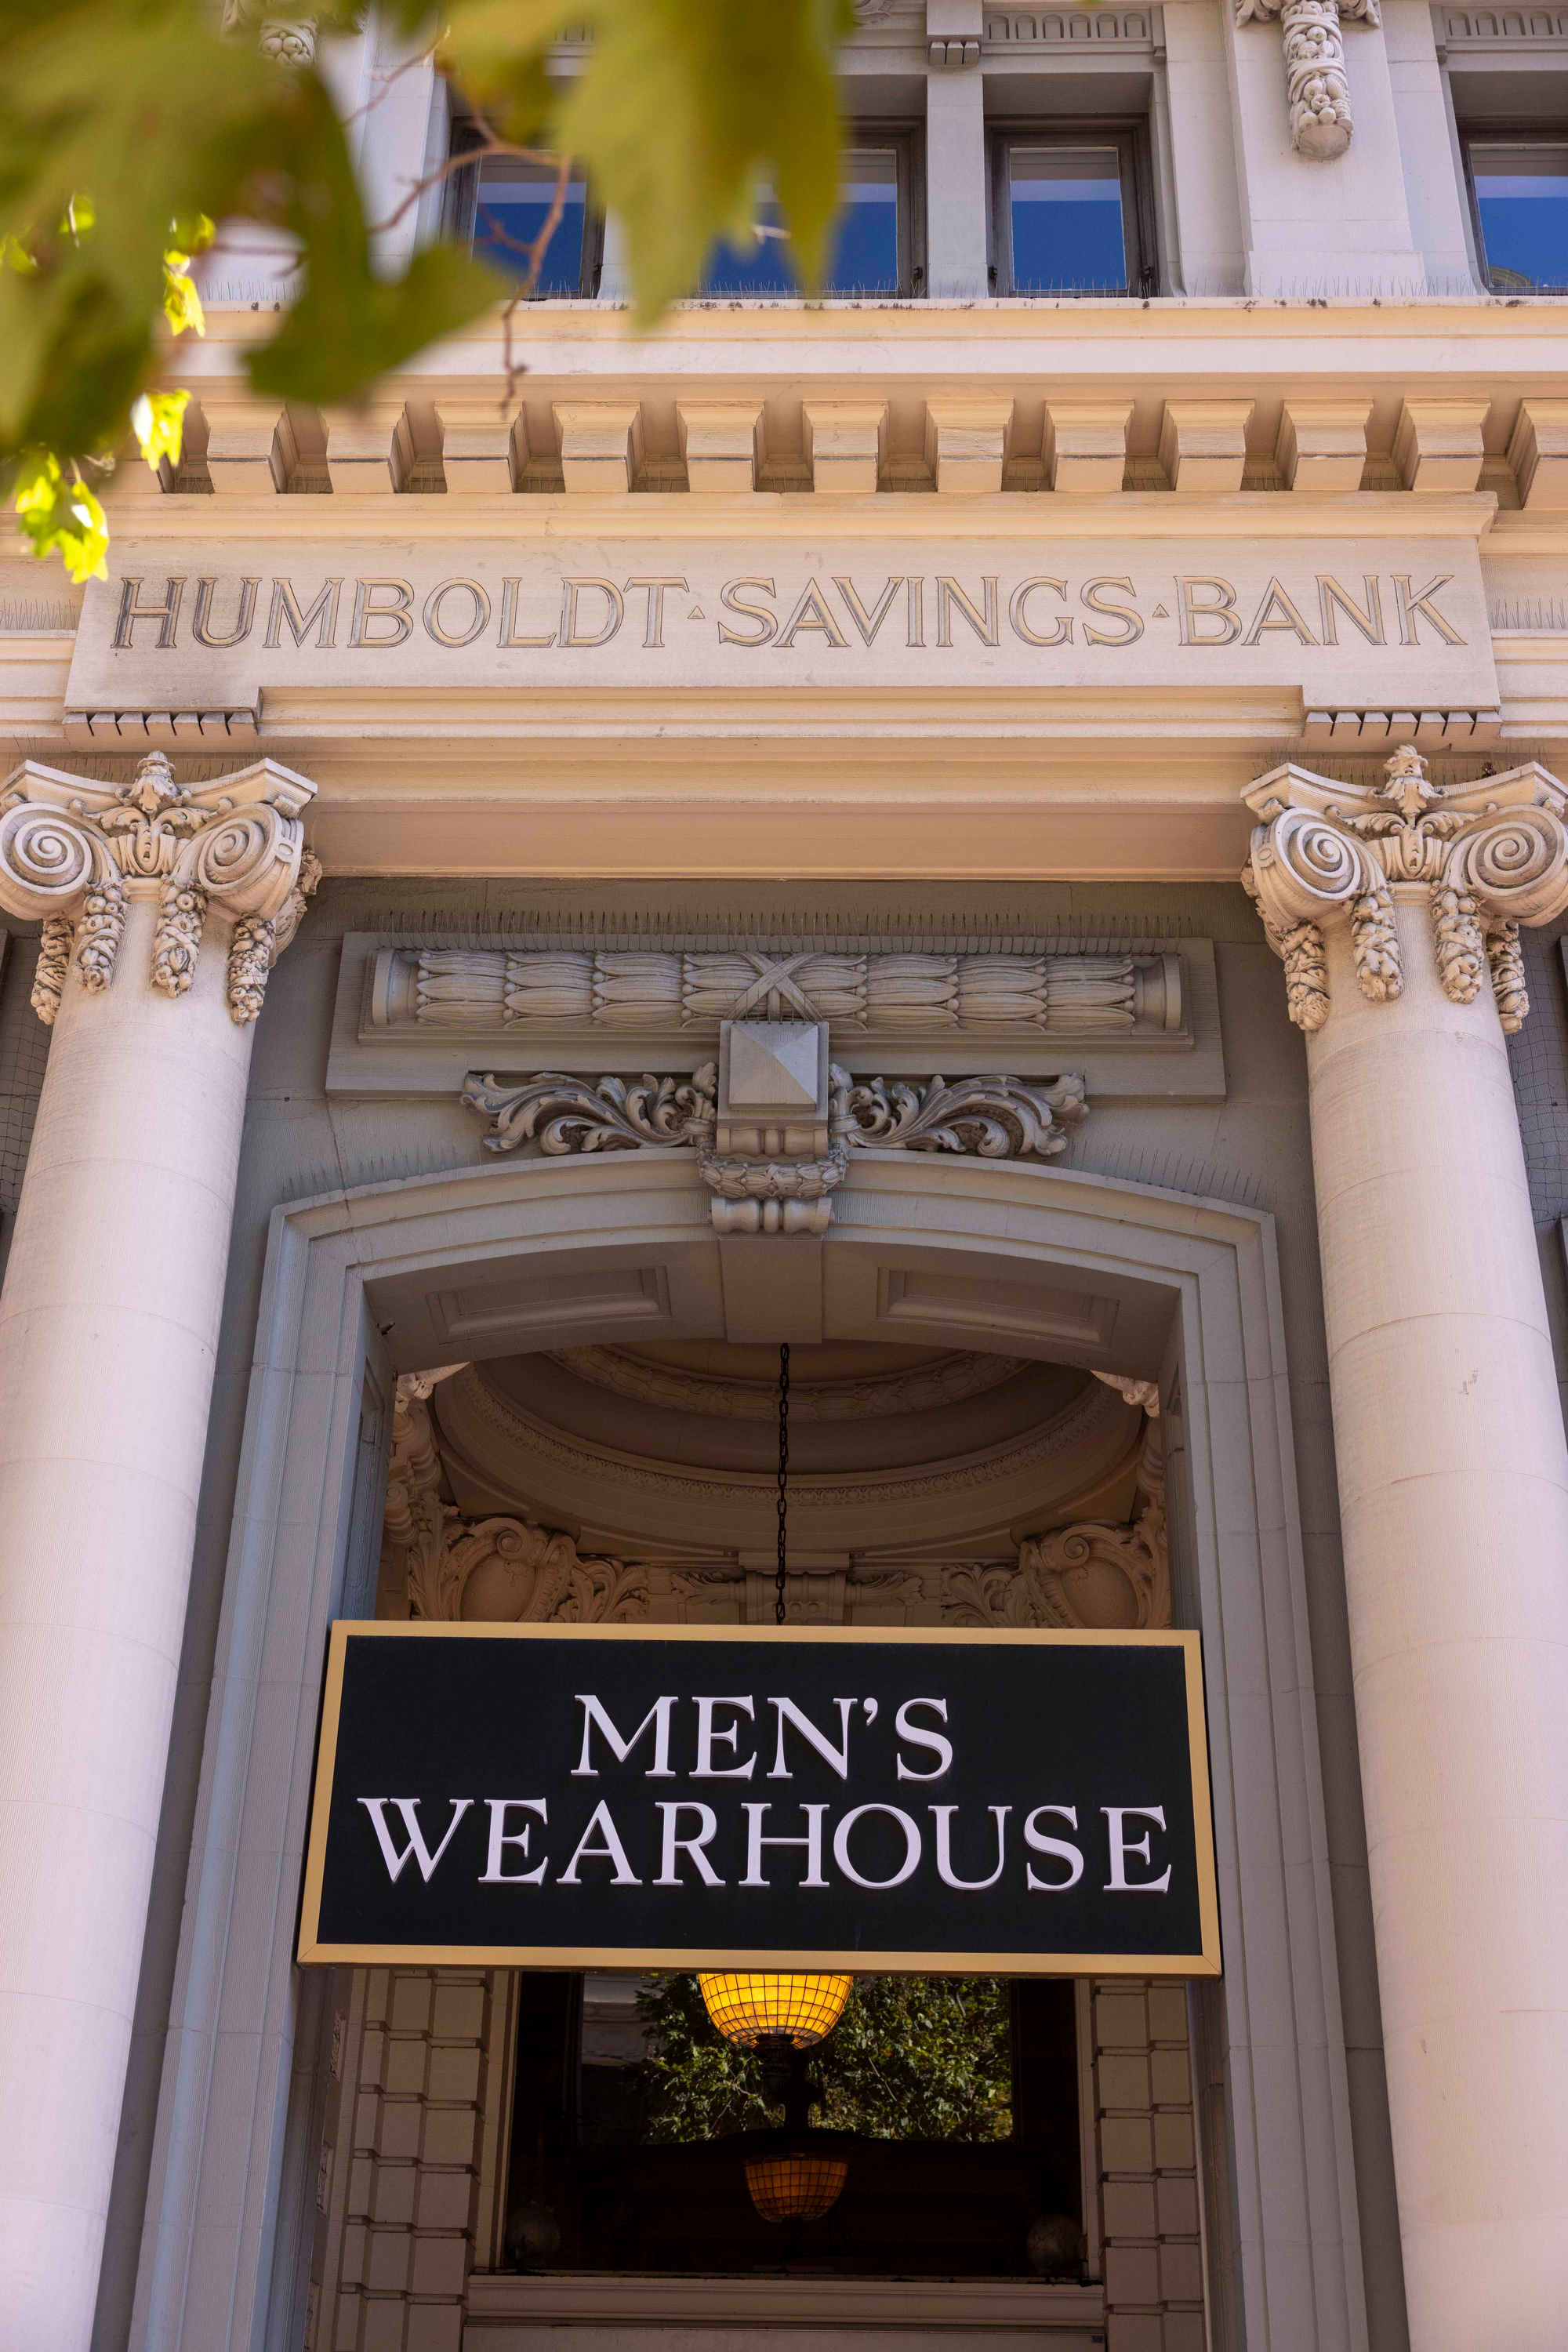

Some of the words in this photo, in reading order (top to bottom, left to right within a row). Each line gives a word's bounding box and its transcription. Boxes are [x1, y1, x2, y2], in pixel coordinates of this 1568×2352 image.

[110, 576, 690, 649] HUMBOLDT
[717, 575, 1145, 648] SAVINGS
[1173, 575, 1468, 647] BANK
[570, 1693, 954, 1782] MEN'S
[356, 1797, 1173, 1893] WEARHOUSE
